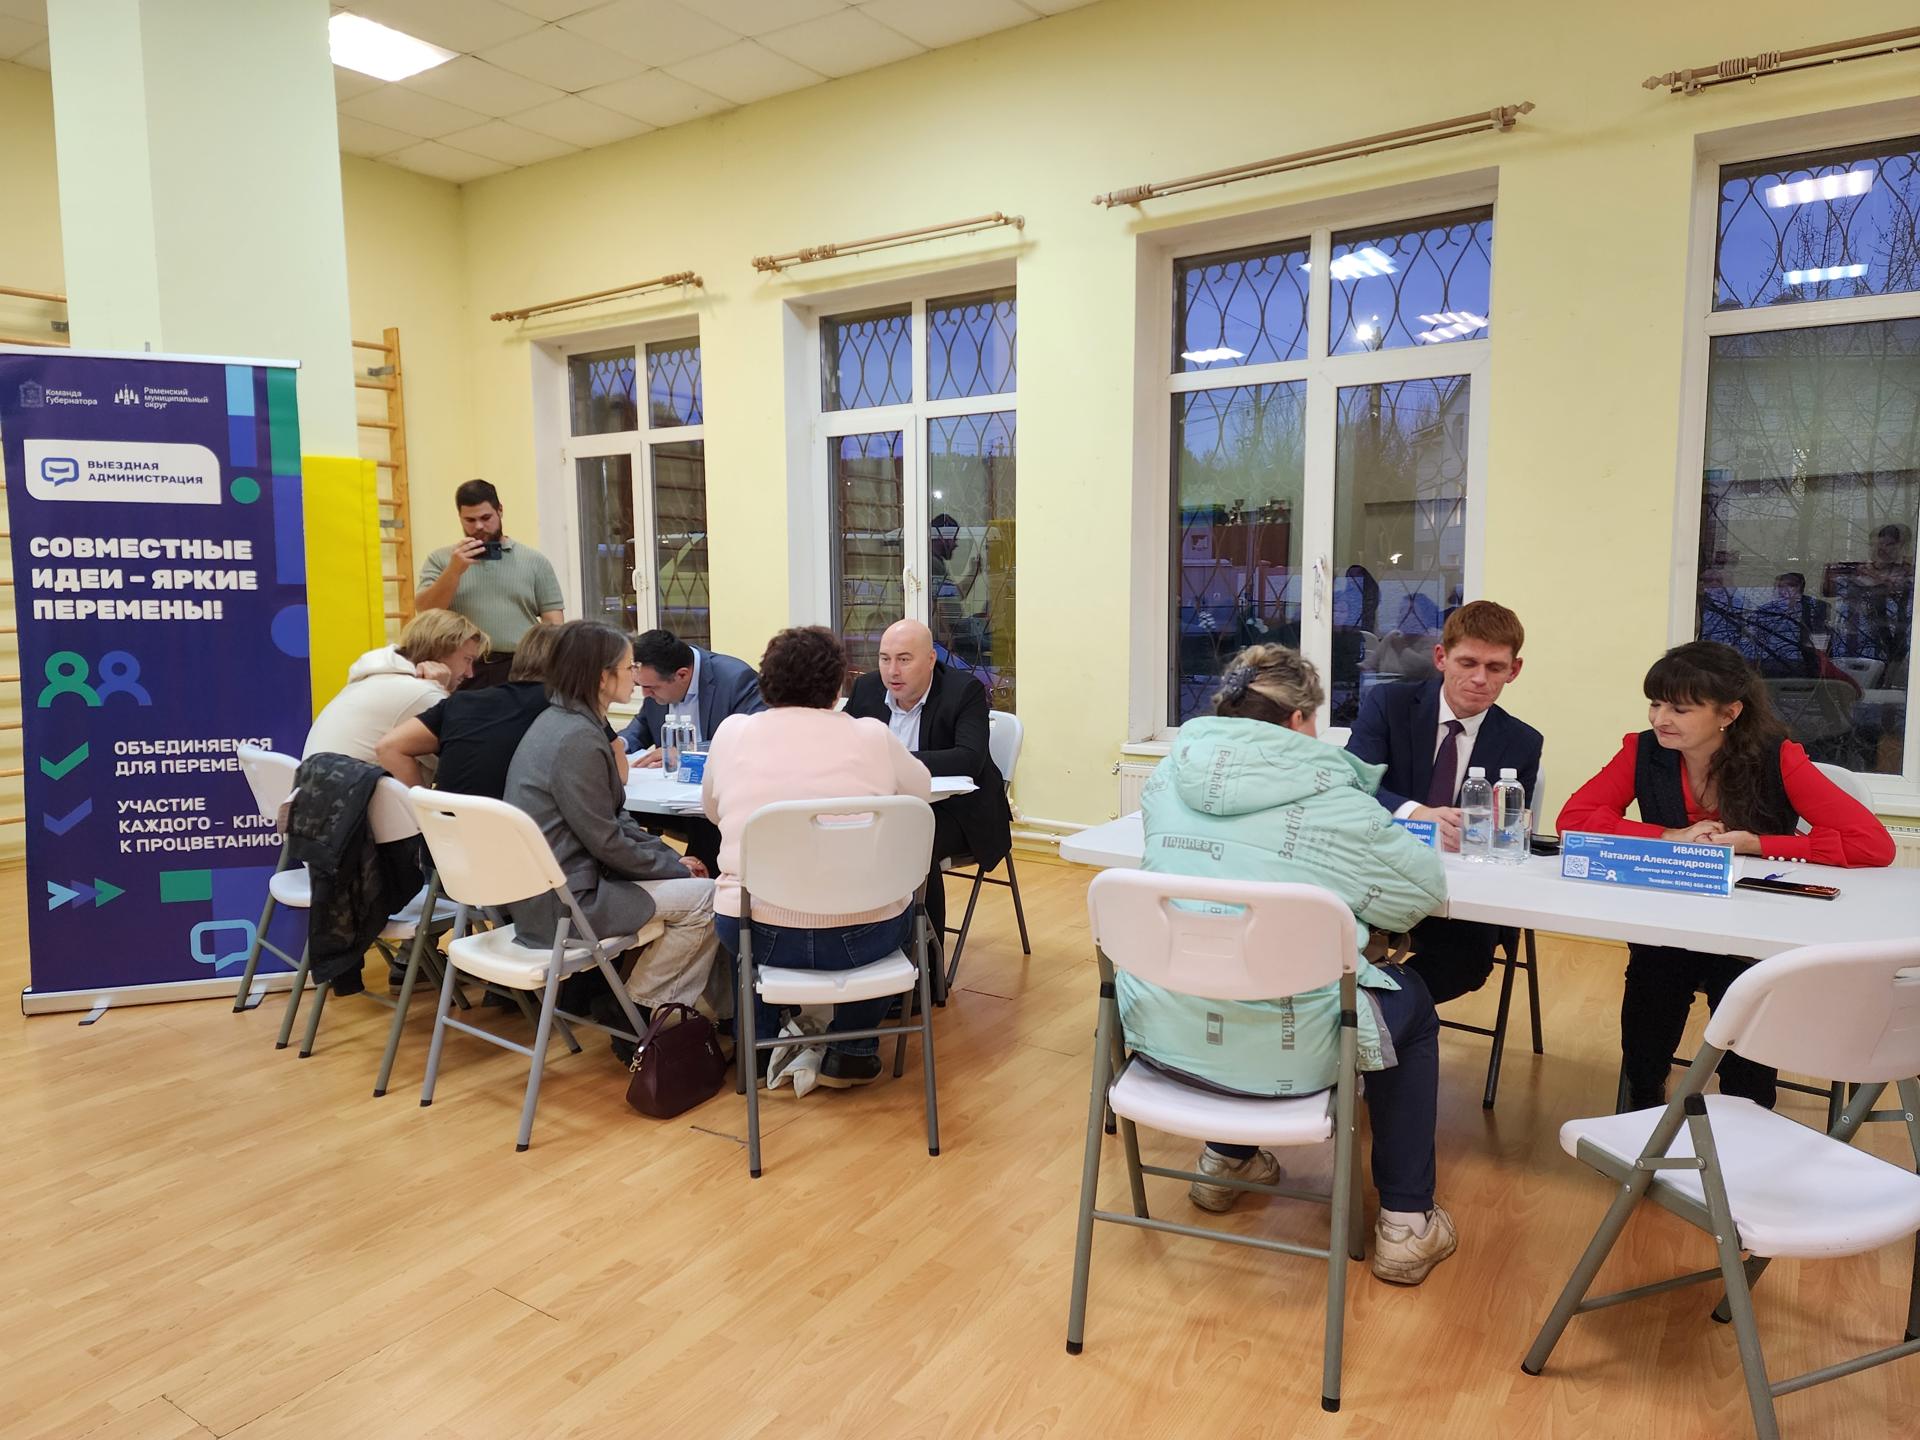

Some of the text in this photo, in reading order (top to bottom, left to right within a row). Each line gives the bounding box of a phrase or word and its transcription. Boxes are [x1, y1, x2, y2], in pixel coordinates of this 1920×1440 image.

[45, 389, 82, 398] Команда
[144, 386, 189, 396] Раменский
[45, 396, 98, 407] Губернатора
[144, 394, 209, 404] муниципальный
[144, 401, 168, 409] округ
[87, 460, 159, 471] ВЫЕЗДНАЯ
[88, 473, 203, 485] АДМИНИСТРАЦИЯ
[29, 537, 253, 560] СОВМЕСТНЫЕ
[31, 568, 123, 592] ИДЕИ
[151, 569, 258, 590] ЯРКИЕ
[33, 599, 223, 620] ПЕРЕМЕНЫ!
[115, 760, 157, 776] ДЛЯ
[117, 797, 206, 814] УЧАСТИЕ
[119, 816, 211, 834] КАЖДОГО
[232, 814, 277, 829] КЛЮ
[120, 840, 132, 853] К
[1672, 845, 1725, 858] ИВАНОВА
[1600, 850, 1724, 870] Наталия Александровна
